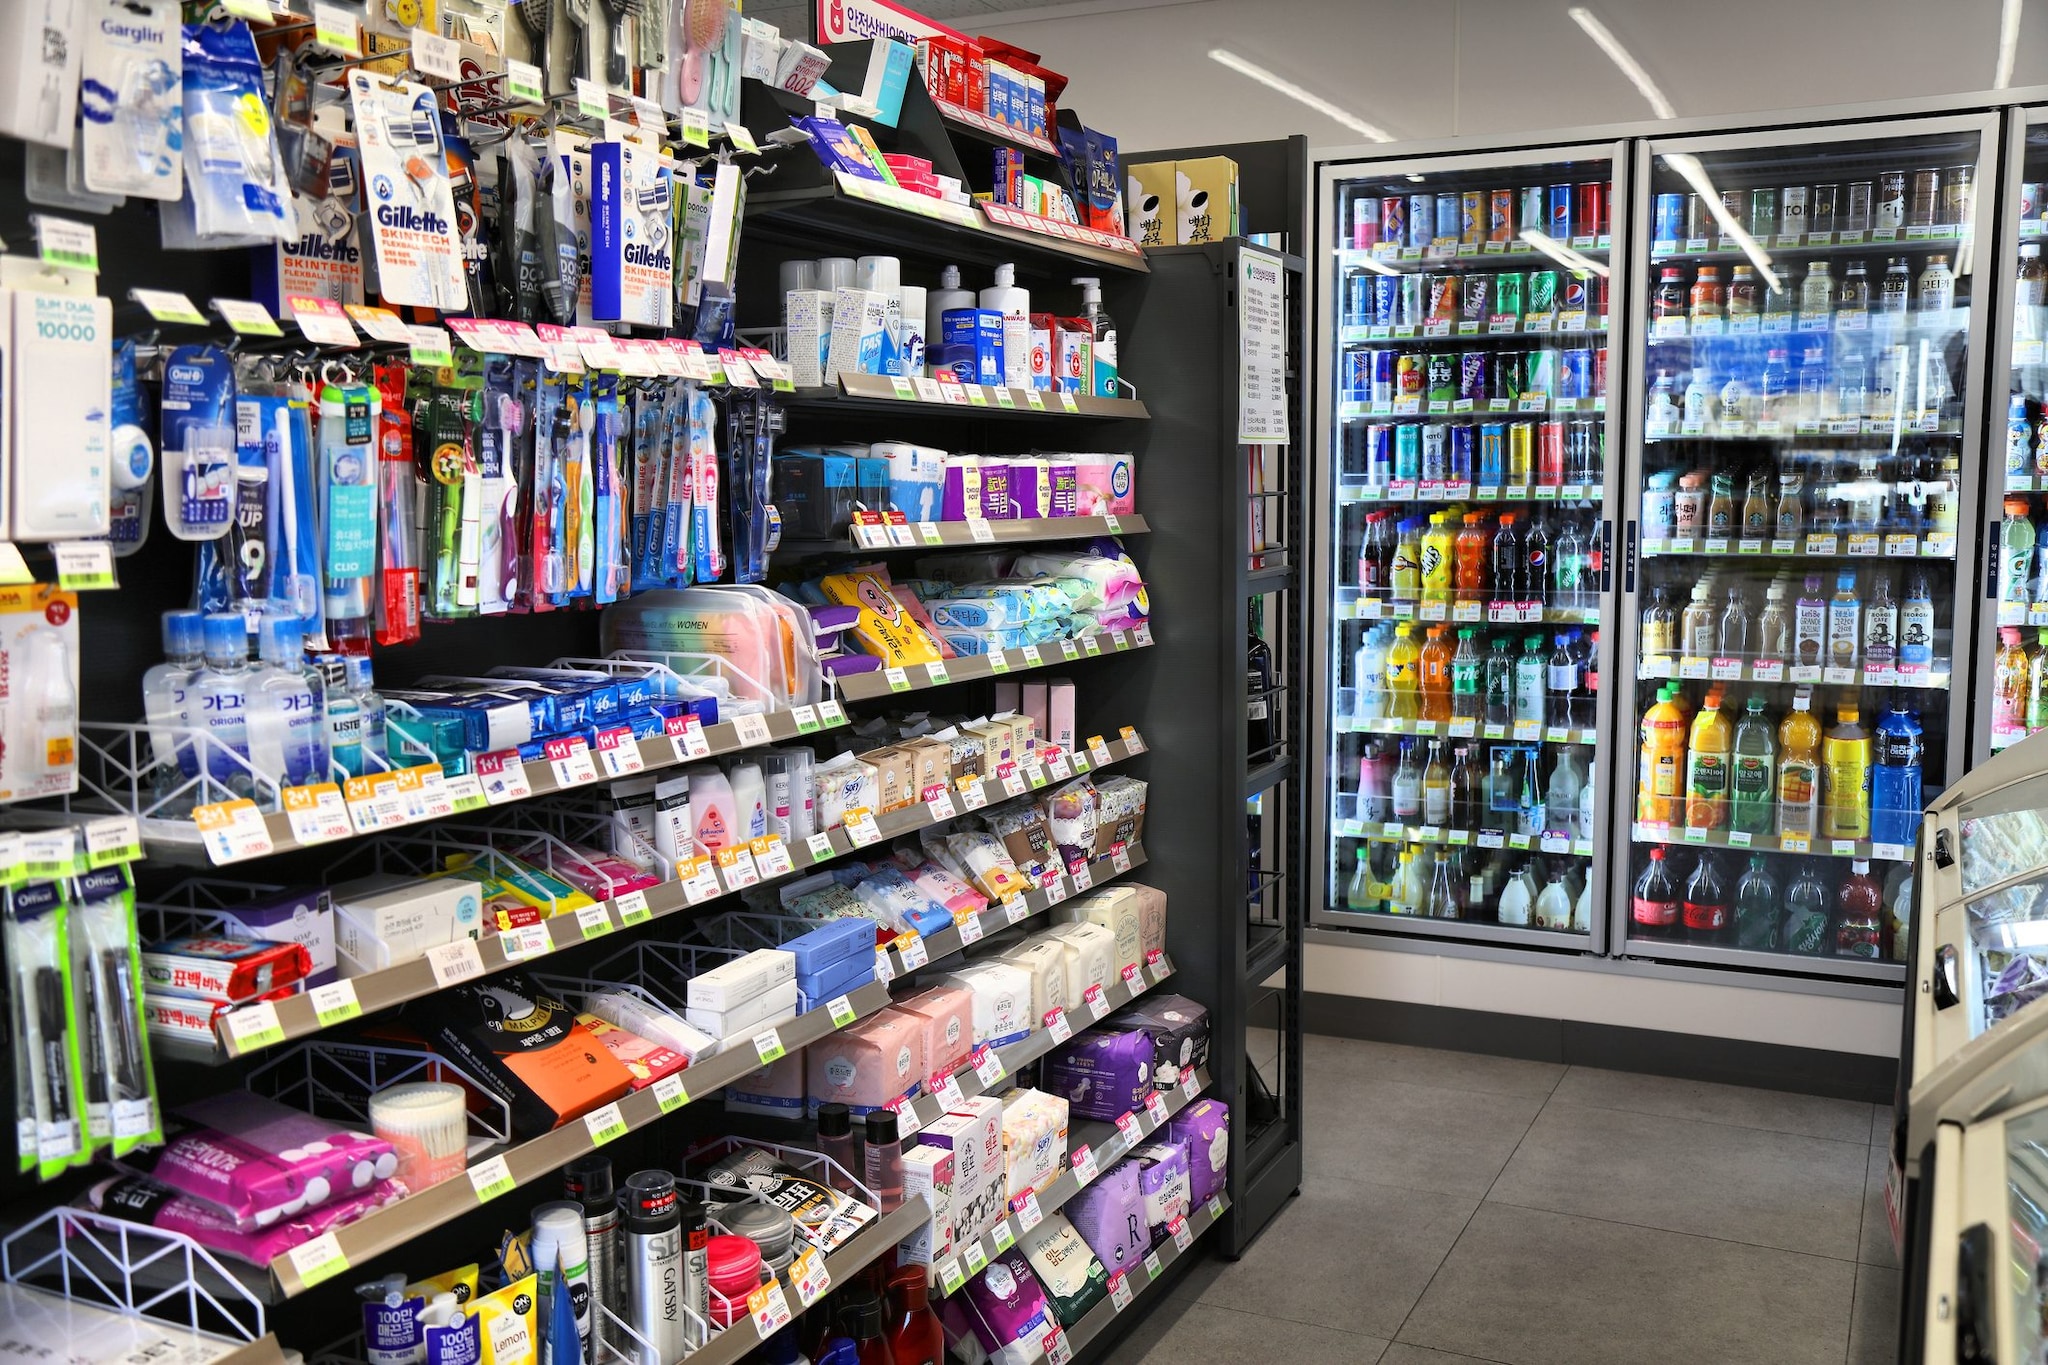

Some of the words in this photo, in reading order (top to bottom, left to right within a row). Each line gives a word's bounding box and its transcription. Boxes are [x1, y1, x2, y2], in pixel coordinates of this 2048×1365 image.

[101, 19, 164, 44] Garglin
[889, 48, 910, 71] GEL
[784, 73, 815, 96] 0.02
[377, 204, 448, 234] Gillette
[1140, 218, 1163, 232] 백화
[1188, 213, 1212, 228] 백화
[380, 228, 450, 246] SKINTECH
[1140, 232, 1161, 246] 수복
[1189, 226, 1211, 242] 수복
[282, 234, 359, 262] Gillette
[382, 239, 420, 250] FLEXBALL
[624, 243, 671, 270] Gillette
[284, 257, 359, 275] SKINTECH
[624, 265, 671, 281] SKINTECH
[284, 269, 326, 280] FLEXBALL
[1922, 279, 1950, 289] 고티카
[65, 300, 94, 313] DUAL
[1465, 281, 1488, 318] Welch's
[37, 322, 95, 341] 10000
[863, 334, 882, 352] PAS
[172, 369, 200, 381] Oral-B
[238, 425, 251, 434] KIT
[239, 503, 262, 513] FRESH
[240, 511, 263, 527] UP
[650, 516, 661, 550] Oral-B
[667, 508, 675, 547] Oral-B
[698, 512, 706, 549] Oral-B
[638, 524, 647, 556] Oral-B
[240, 539, 265, 580] 9
[1990, 543, 1998, 577] 당기세요
[334, 563, 359, 572] CLIO
[951, 609, 982, 623] 물티슈
[1800, 618, 1821, 626] GRANDE
[1834, 618, 1854, 626] 그란데
[677, 620, 709, 630] WOMEN
[1715, 658, 1728, 667] 1+1
[1755, 659, 1769, 668] 1+1
[1867, 664, 1880, 672] 1+1
[1900, 665, 1914, 673] 1+1
[1452, 667, 1480, 682] prite
[283, 690, 323, 711] 가그린
[575, 703, 586, 724] 7
[667, 719, 685, 734] 1+1
[598, 733, 615, 748] 1+1
[548, 742, 568, 758] 1+1
[478, 757, 499, 772] 1+1
[396, 771, 417, 787] 2+1
[348, 780, 369, 796] 2+1
[844, 779, 860, 795] SOFY
[286, 789, 312, 806] 2+1
[924, 790, 937, 800] 1+1
[200, 808, 227, 824] 2+1
[752, 838, 766, 852] 2+1
[719, 849, 735, 863] 2+1
[678, 860, 695, 876] 2+1
[1001, 892, 1012, 904] 2+1
[956, 911, 967, 923] 2+1
[897, 936, 910, 949] 2+1
[1124, 969, 1134, 979] 1+1
[1087, 991, 1096, 1001] 1+1
[508, 1011, 548, 1030] MALPYO
[1046, 1015, 1056, 1025] 1+1
[972, 1056, 985, 1068] 1+1
[828, 1067, 852, 1077] 좋은느낌
[1181, 1072, 1190, 1082] 1+1
[932, 1079, 946, 1092] 1+1
[1146, 1097, 1156, 1107] 1+1
[1118, 1118, 1129, 1129] 1+1
[985, 1134, 998, 1156] 템포
[1036, 1137, 1051, 1153] SOFY
[1073, 1153, 1084, 1164] 1+1
[961, 1157, 976, 1178] 템포
[650, 1204, 676, 1216] 스프레이
[1014, 1198, 1027, 1210] 1+1
[1169, 1223, 1180, 1234] 1+1
[1045, 1248, 1065, 1267] 입는
[791, 1264, 805, 1279] 2+1
[663, 1266, 677, 1322] GATSBY
[700, 1277, 709, 1314] GATSBY
[750, 1292, 766, 1309] 2+1
[378, 1307, 414, 1324] 100만
[440, 1327, 474, 1347] 100만
[493, 1329, 527, 1353] Lemon
